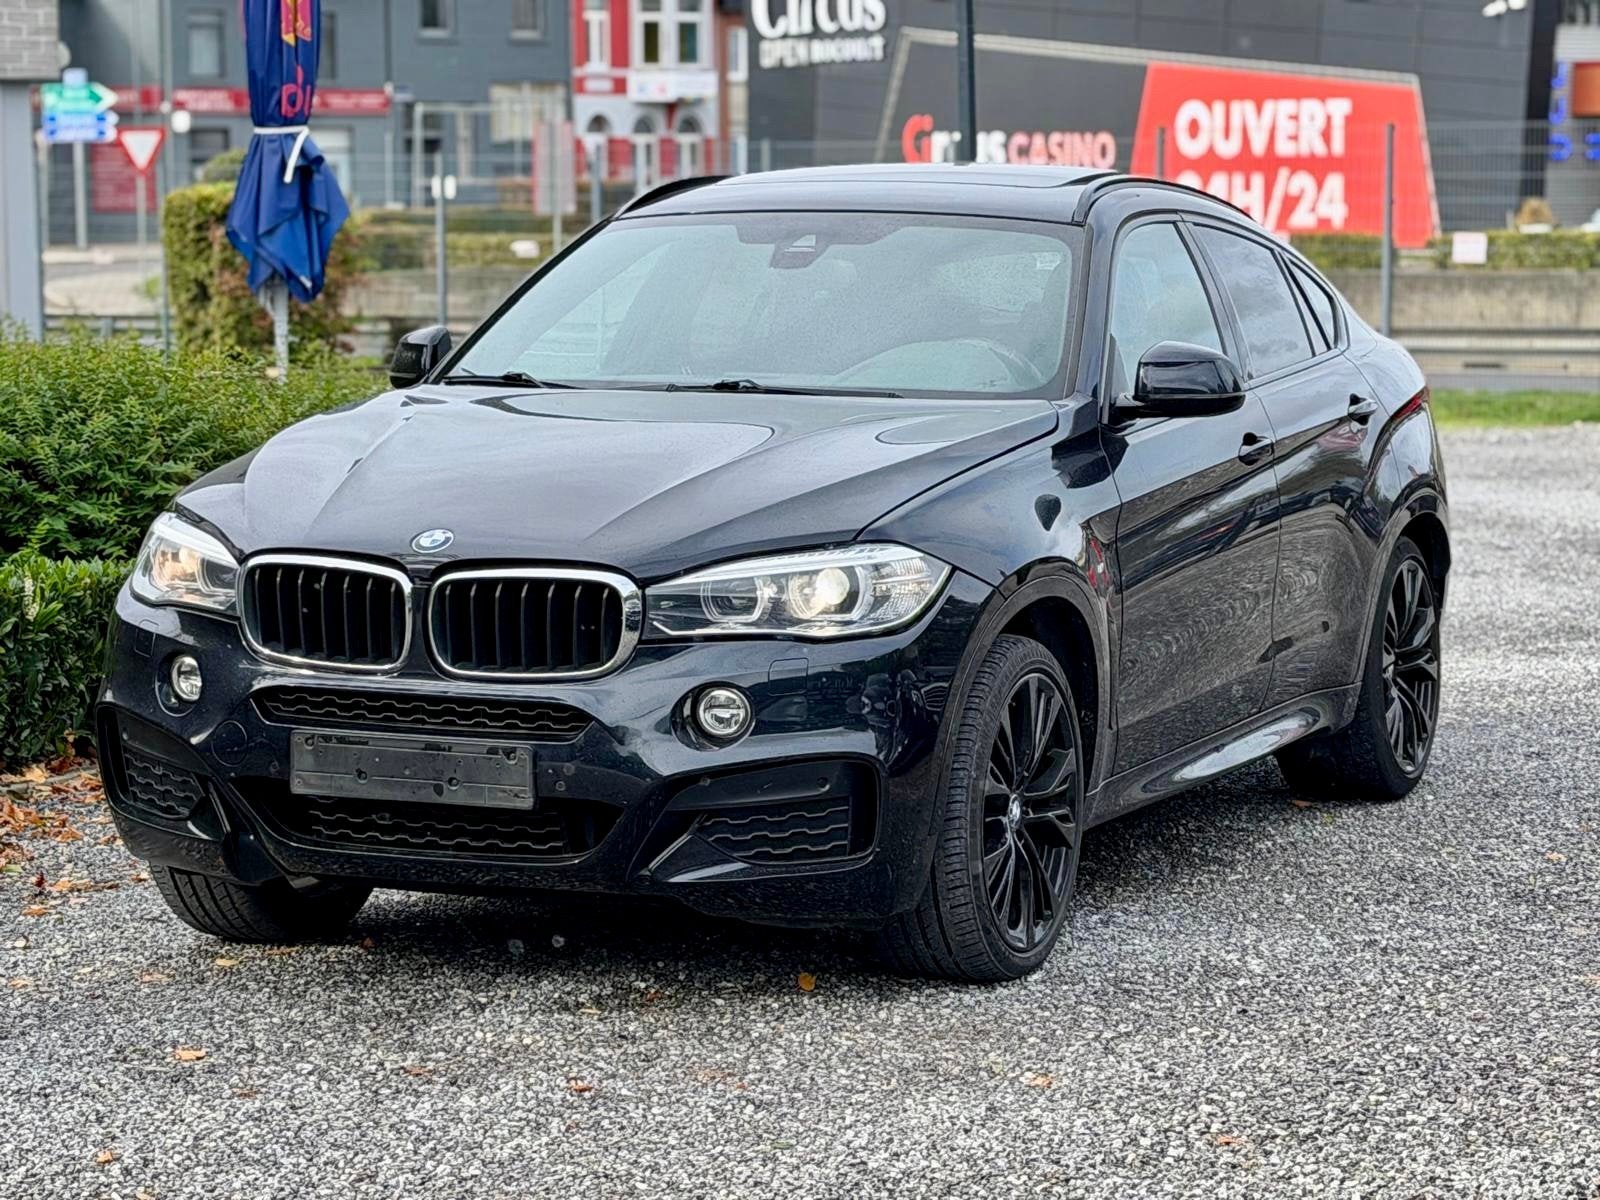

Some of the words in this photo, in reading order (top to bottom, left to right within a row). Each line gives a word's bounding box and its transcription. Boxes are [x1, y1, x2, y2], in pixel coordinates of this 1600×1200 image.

[1007, 130, 1117, 169] CASINO
[1174, 97, 1353, 160] OUVERT
[1176, 166, 1349, 231] H/24
